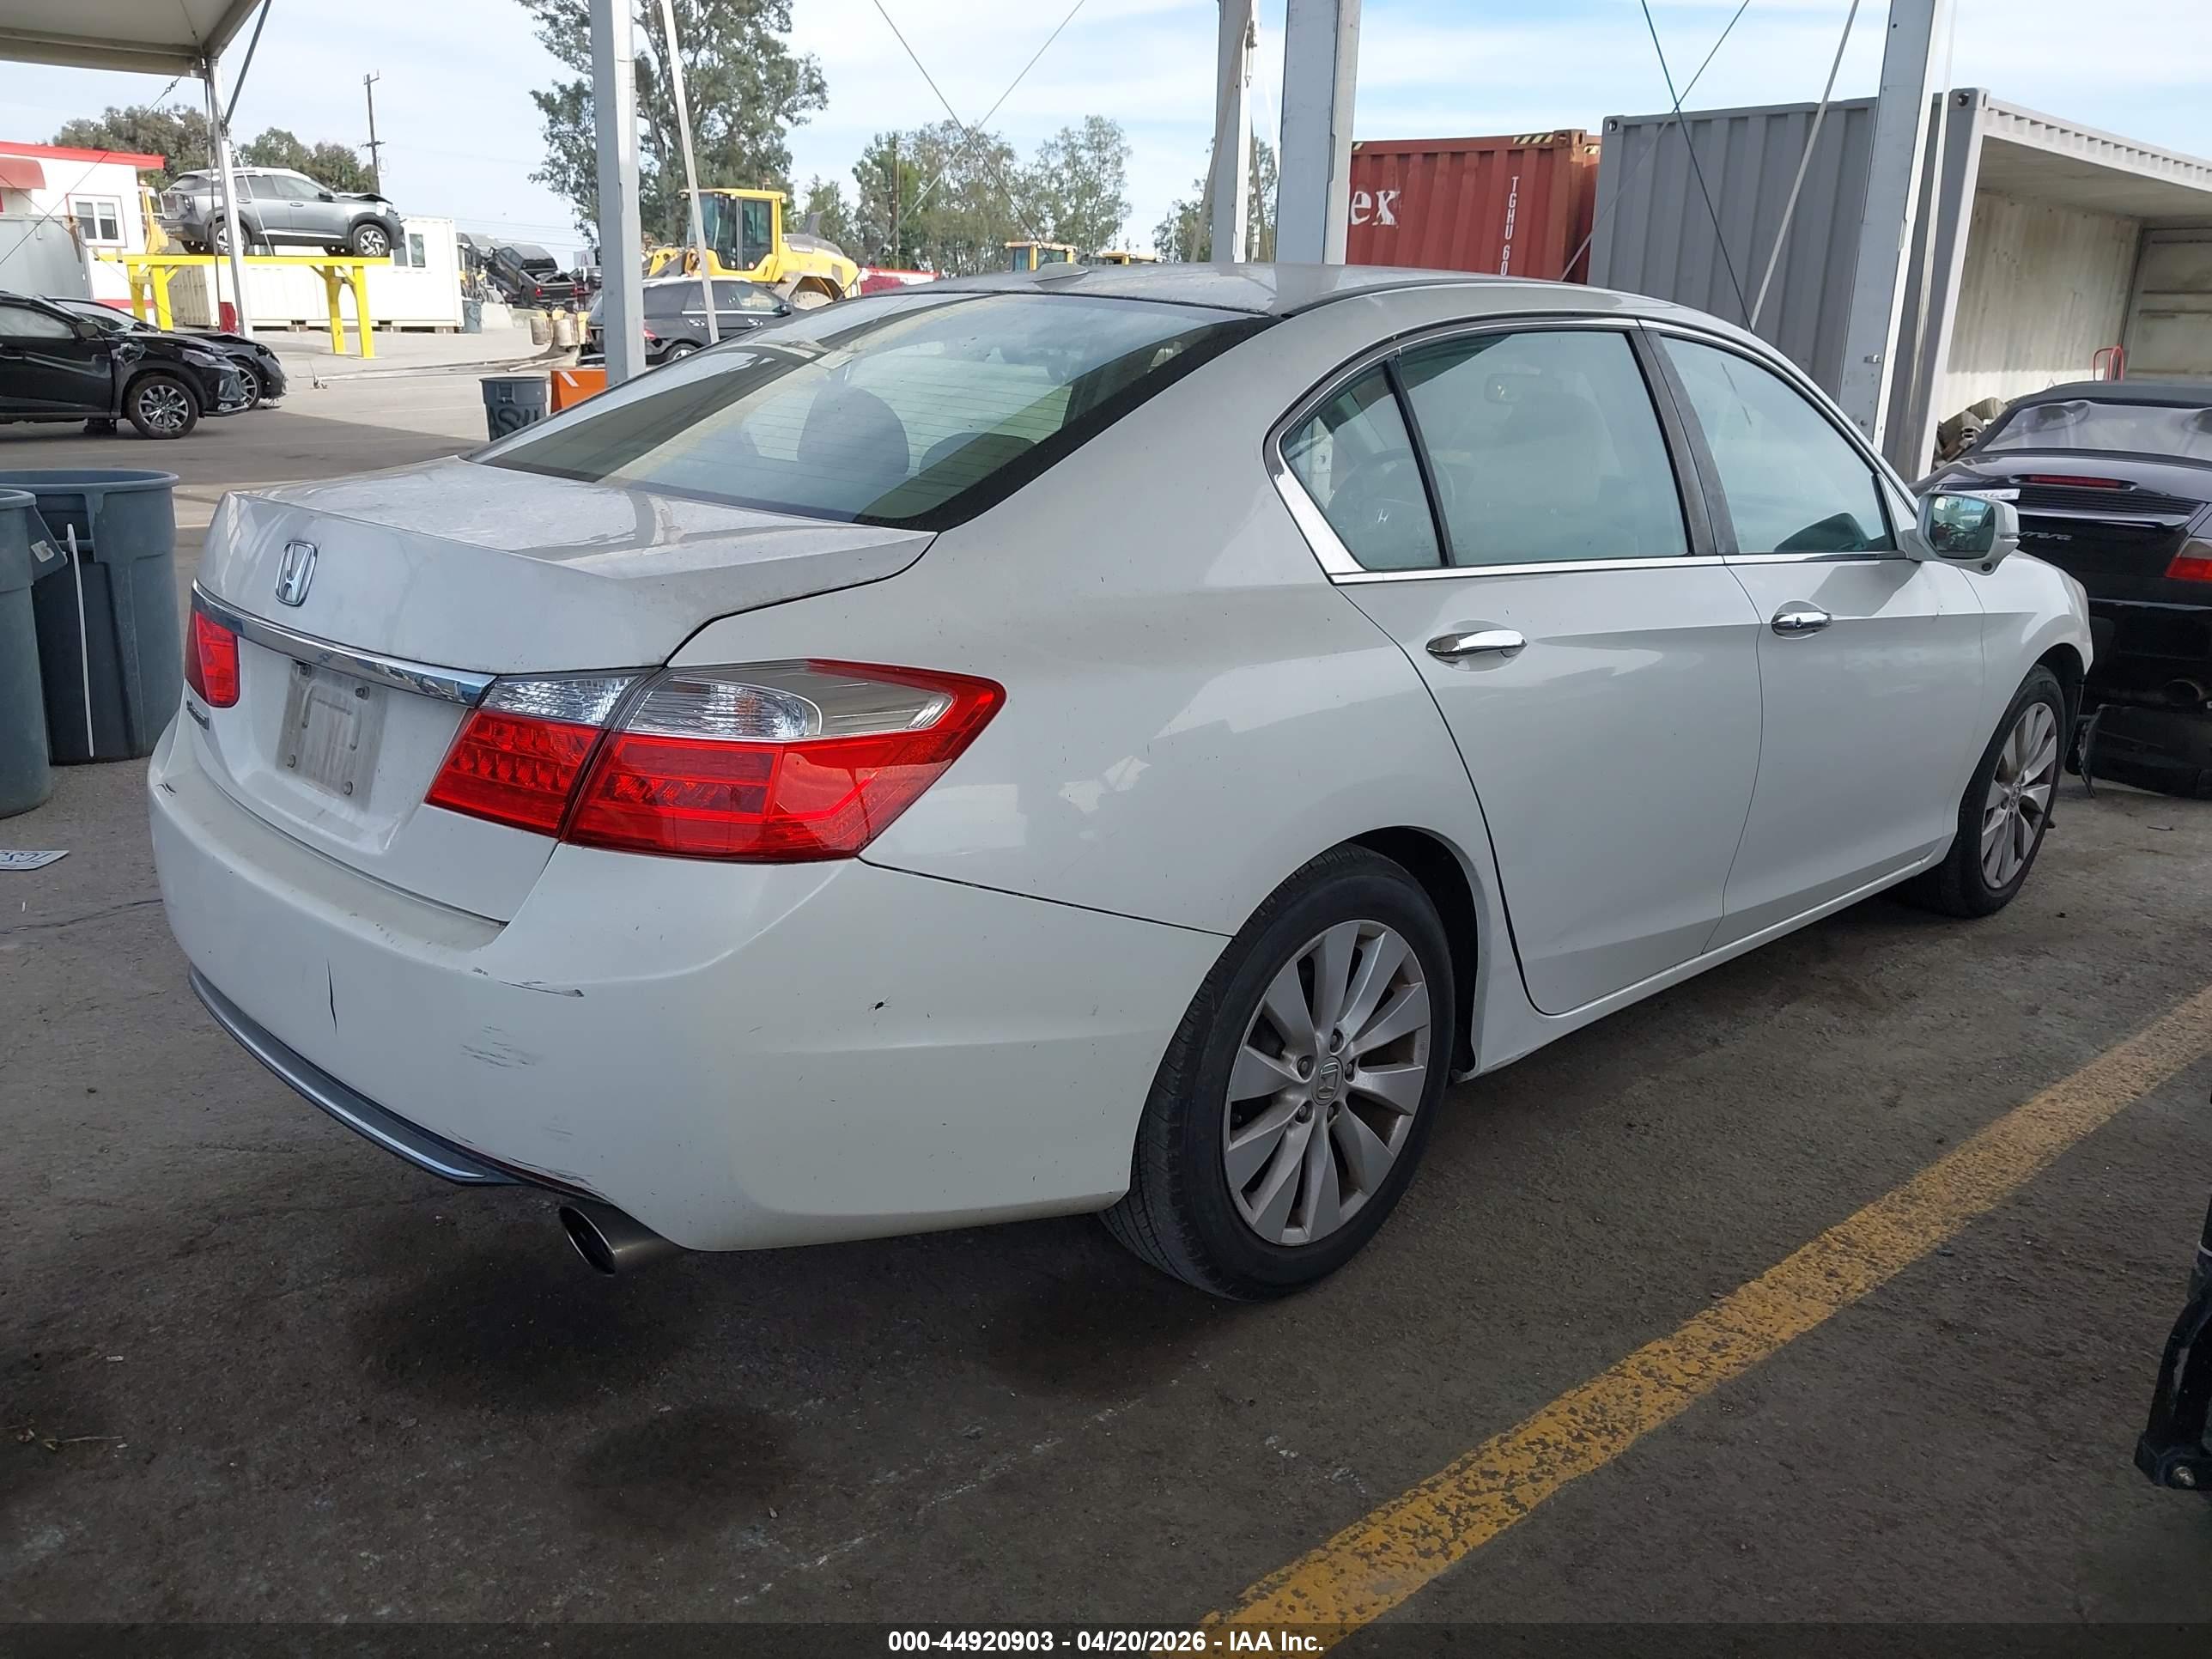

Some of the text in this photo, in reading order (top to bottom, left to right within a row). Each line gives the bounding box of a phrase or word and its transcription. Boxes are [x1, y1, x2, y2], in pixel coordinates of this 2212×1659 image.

[1350, 190, 1401, 226] ex
[1500, 175, 1520, 276] TGHU 60
